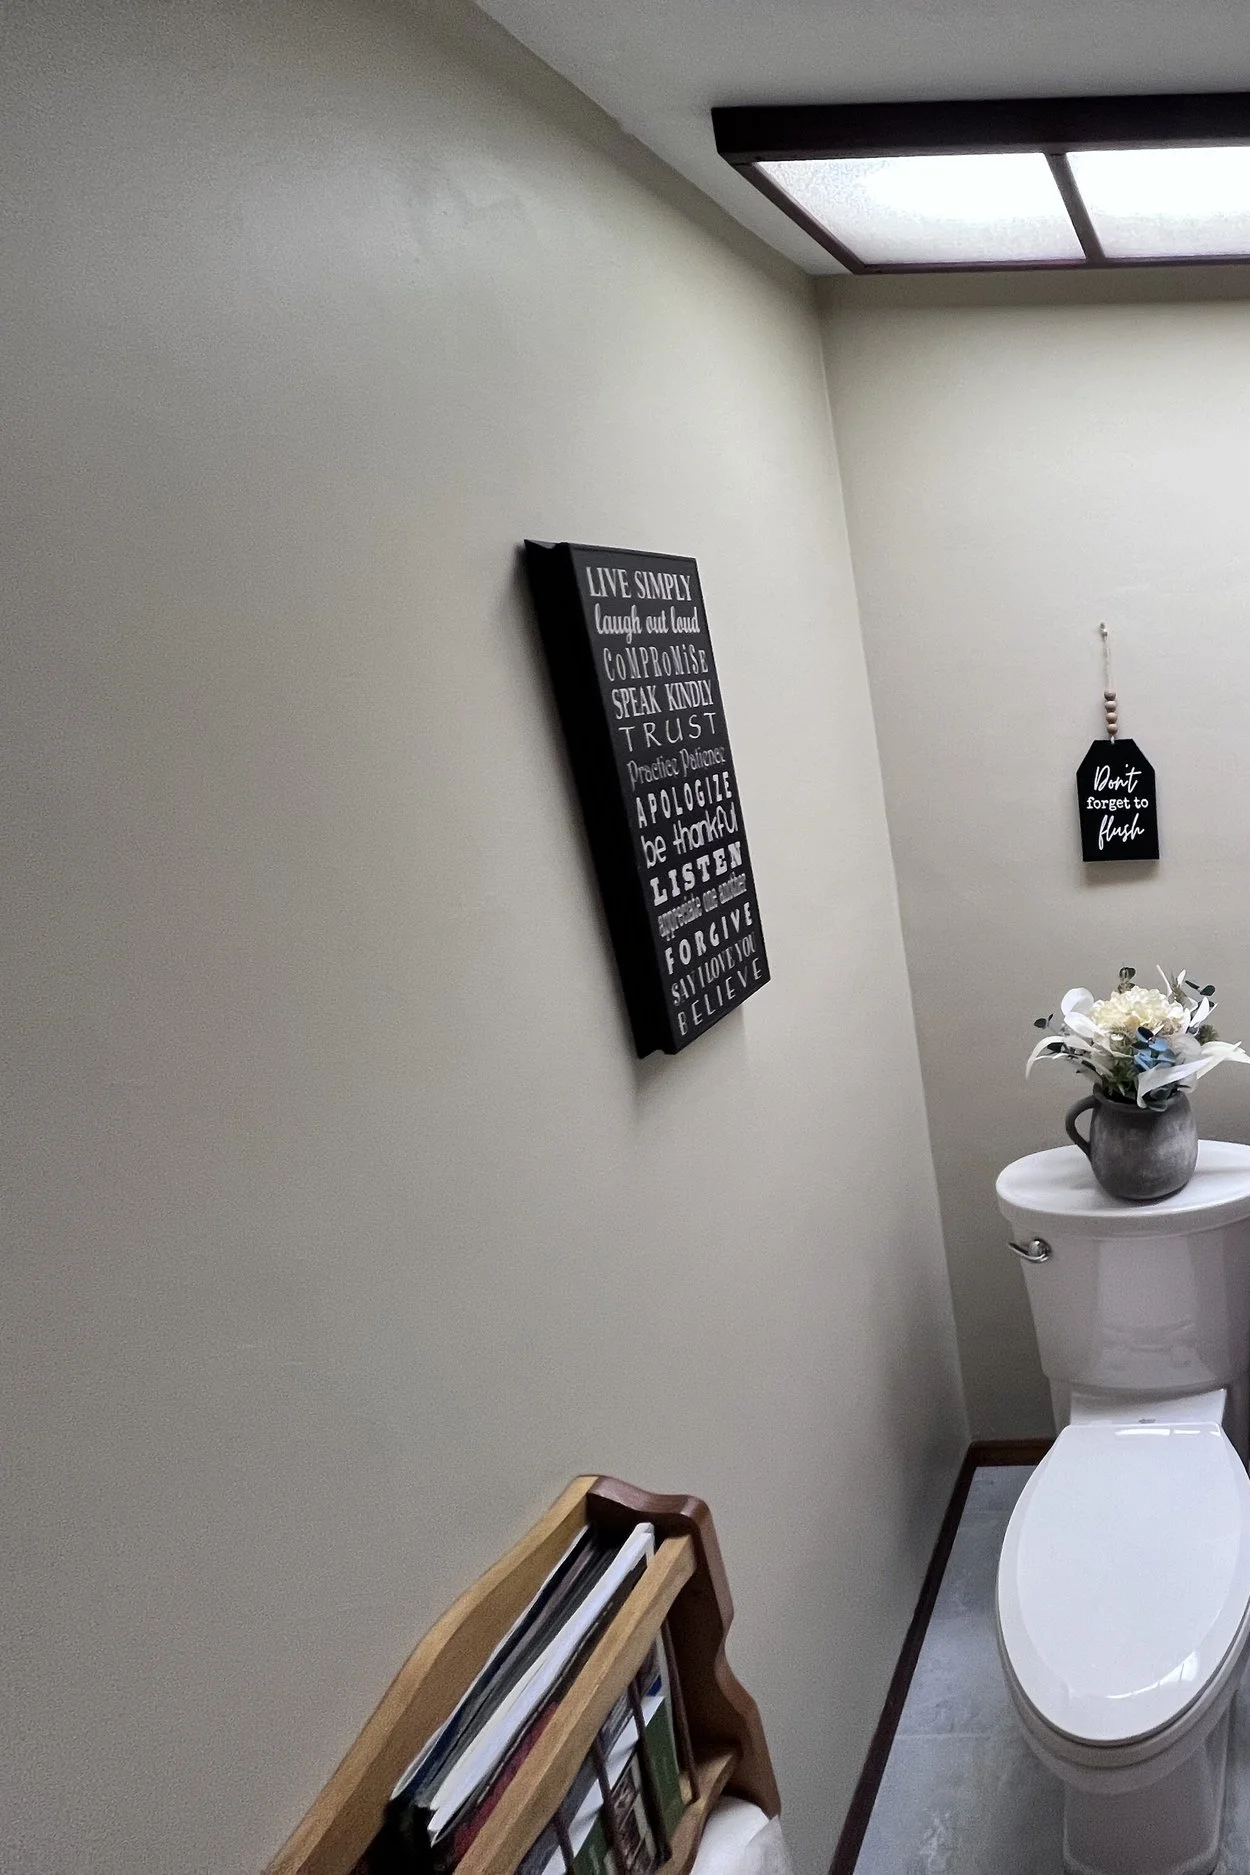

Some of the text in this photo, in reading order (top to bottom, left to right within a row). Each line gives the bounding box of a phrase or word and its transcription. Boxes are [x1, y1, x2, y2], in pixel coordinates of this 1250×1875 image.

[586, 567, 692, 601] LIVE SIMPLY
[594, 603, 700, 644] laugh out loud
[611, 679, 714, 719] SPEAK KINDLY
[618, 712, 716, 752] TRUST
[627, 755, 680, 792] Practice
[1094, 763, 1142, 793] Don't
[635, 771, 732, 829] APOLOGIZE
[1086, 796, 1149, 811] forget to
[641, 802, 738, 868] be thankful
[1098, 813, 1145, 851] flush
[650, 841, 743, 907] LISTEN
[665, 902, 753, 975] FORGIVE
[671, 931, 757, 1007] SAY I LOVE YOU
[677, 957, 762, 1036] BELIEVE
